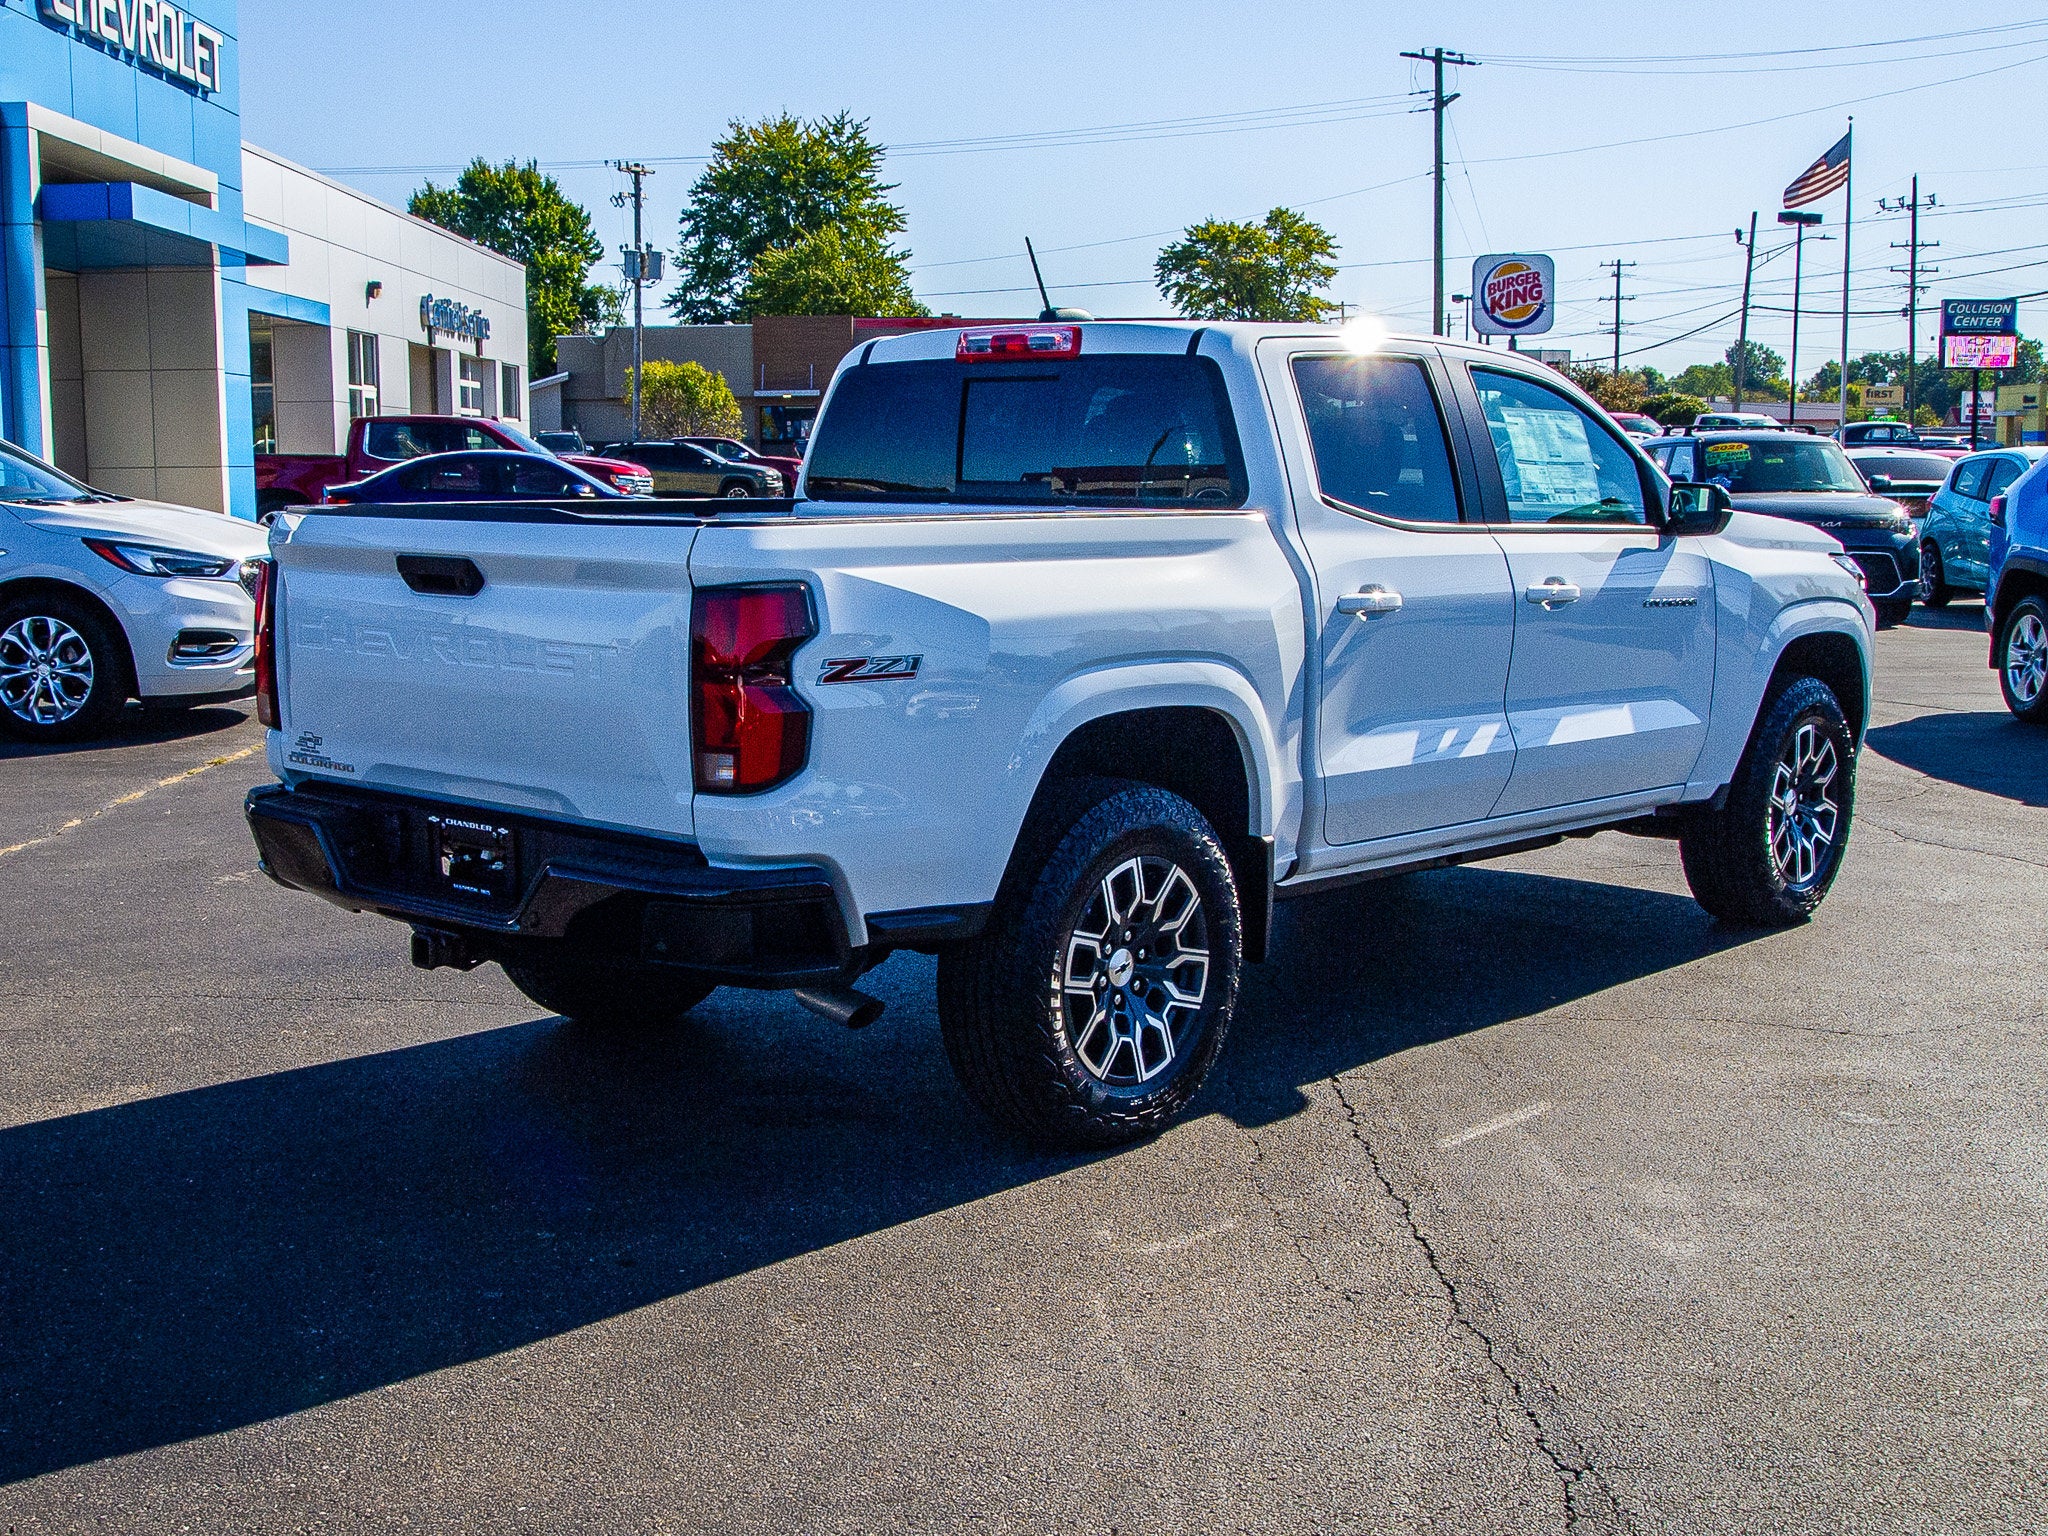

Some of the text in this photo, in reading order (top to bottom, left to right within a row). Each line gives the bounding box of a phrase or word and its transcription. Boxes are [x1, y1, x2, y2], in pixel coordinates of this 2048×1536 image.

[1487, 271, 1541, 297] BURGER
[1490, 283, 1543, 315] KING
[1948, 303, 2012, 314] COLLISION
[1953, 315, 2003, 327] CENTER
[296, 611, 620, 680] CHEVROLET
[815, 654, 924, 687] Z71
[445, 818, 493, 832] CHANDLER
